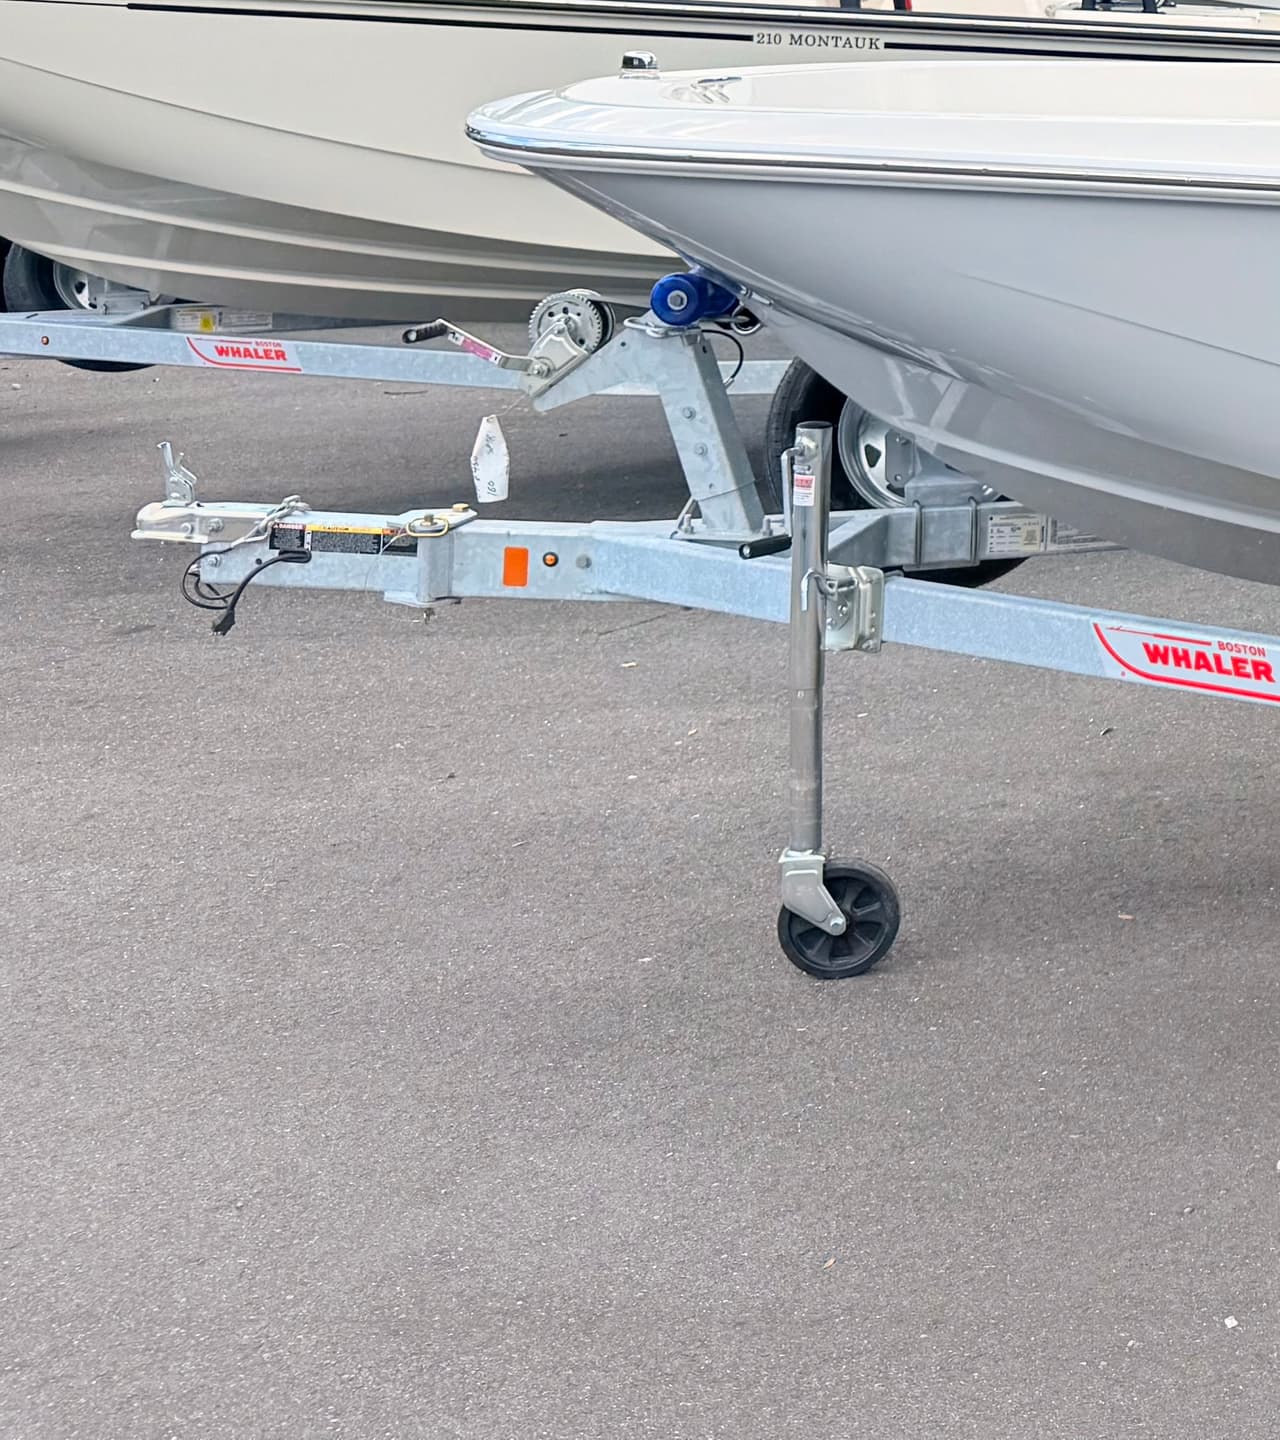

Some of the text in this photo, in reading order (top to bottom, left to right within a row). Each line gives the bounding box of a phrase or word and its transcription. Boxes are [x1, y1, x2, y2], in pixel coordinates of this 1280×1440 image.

[756, 32, 881, 50] 210 MONTAUK
[214, 345, 288, 362] WHALER
[1217, 640, 1266, 657] BOSTON
[1142, 641, 1276, 684] WHALER
